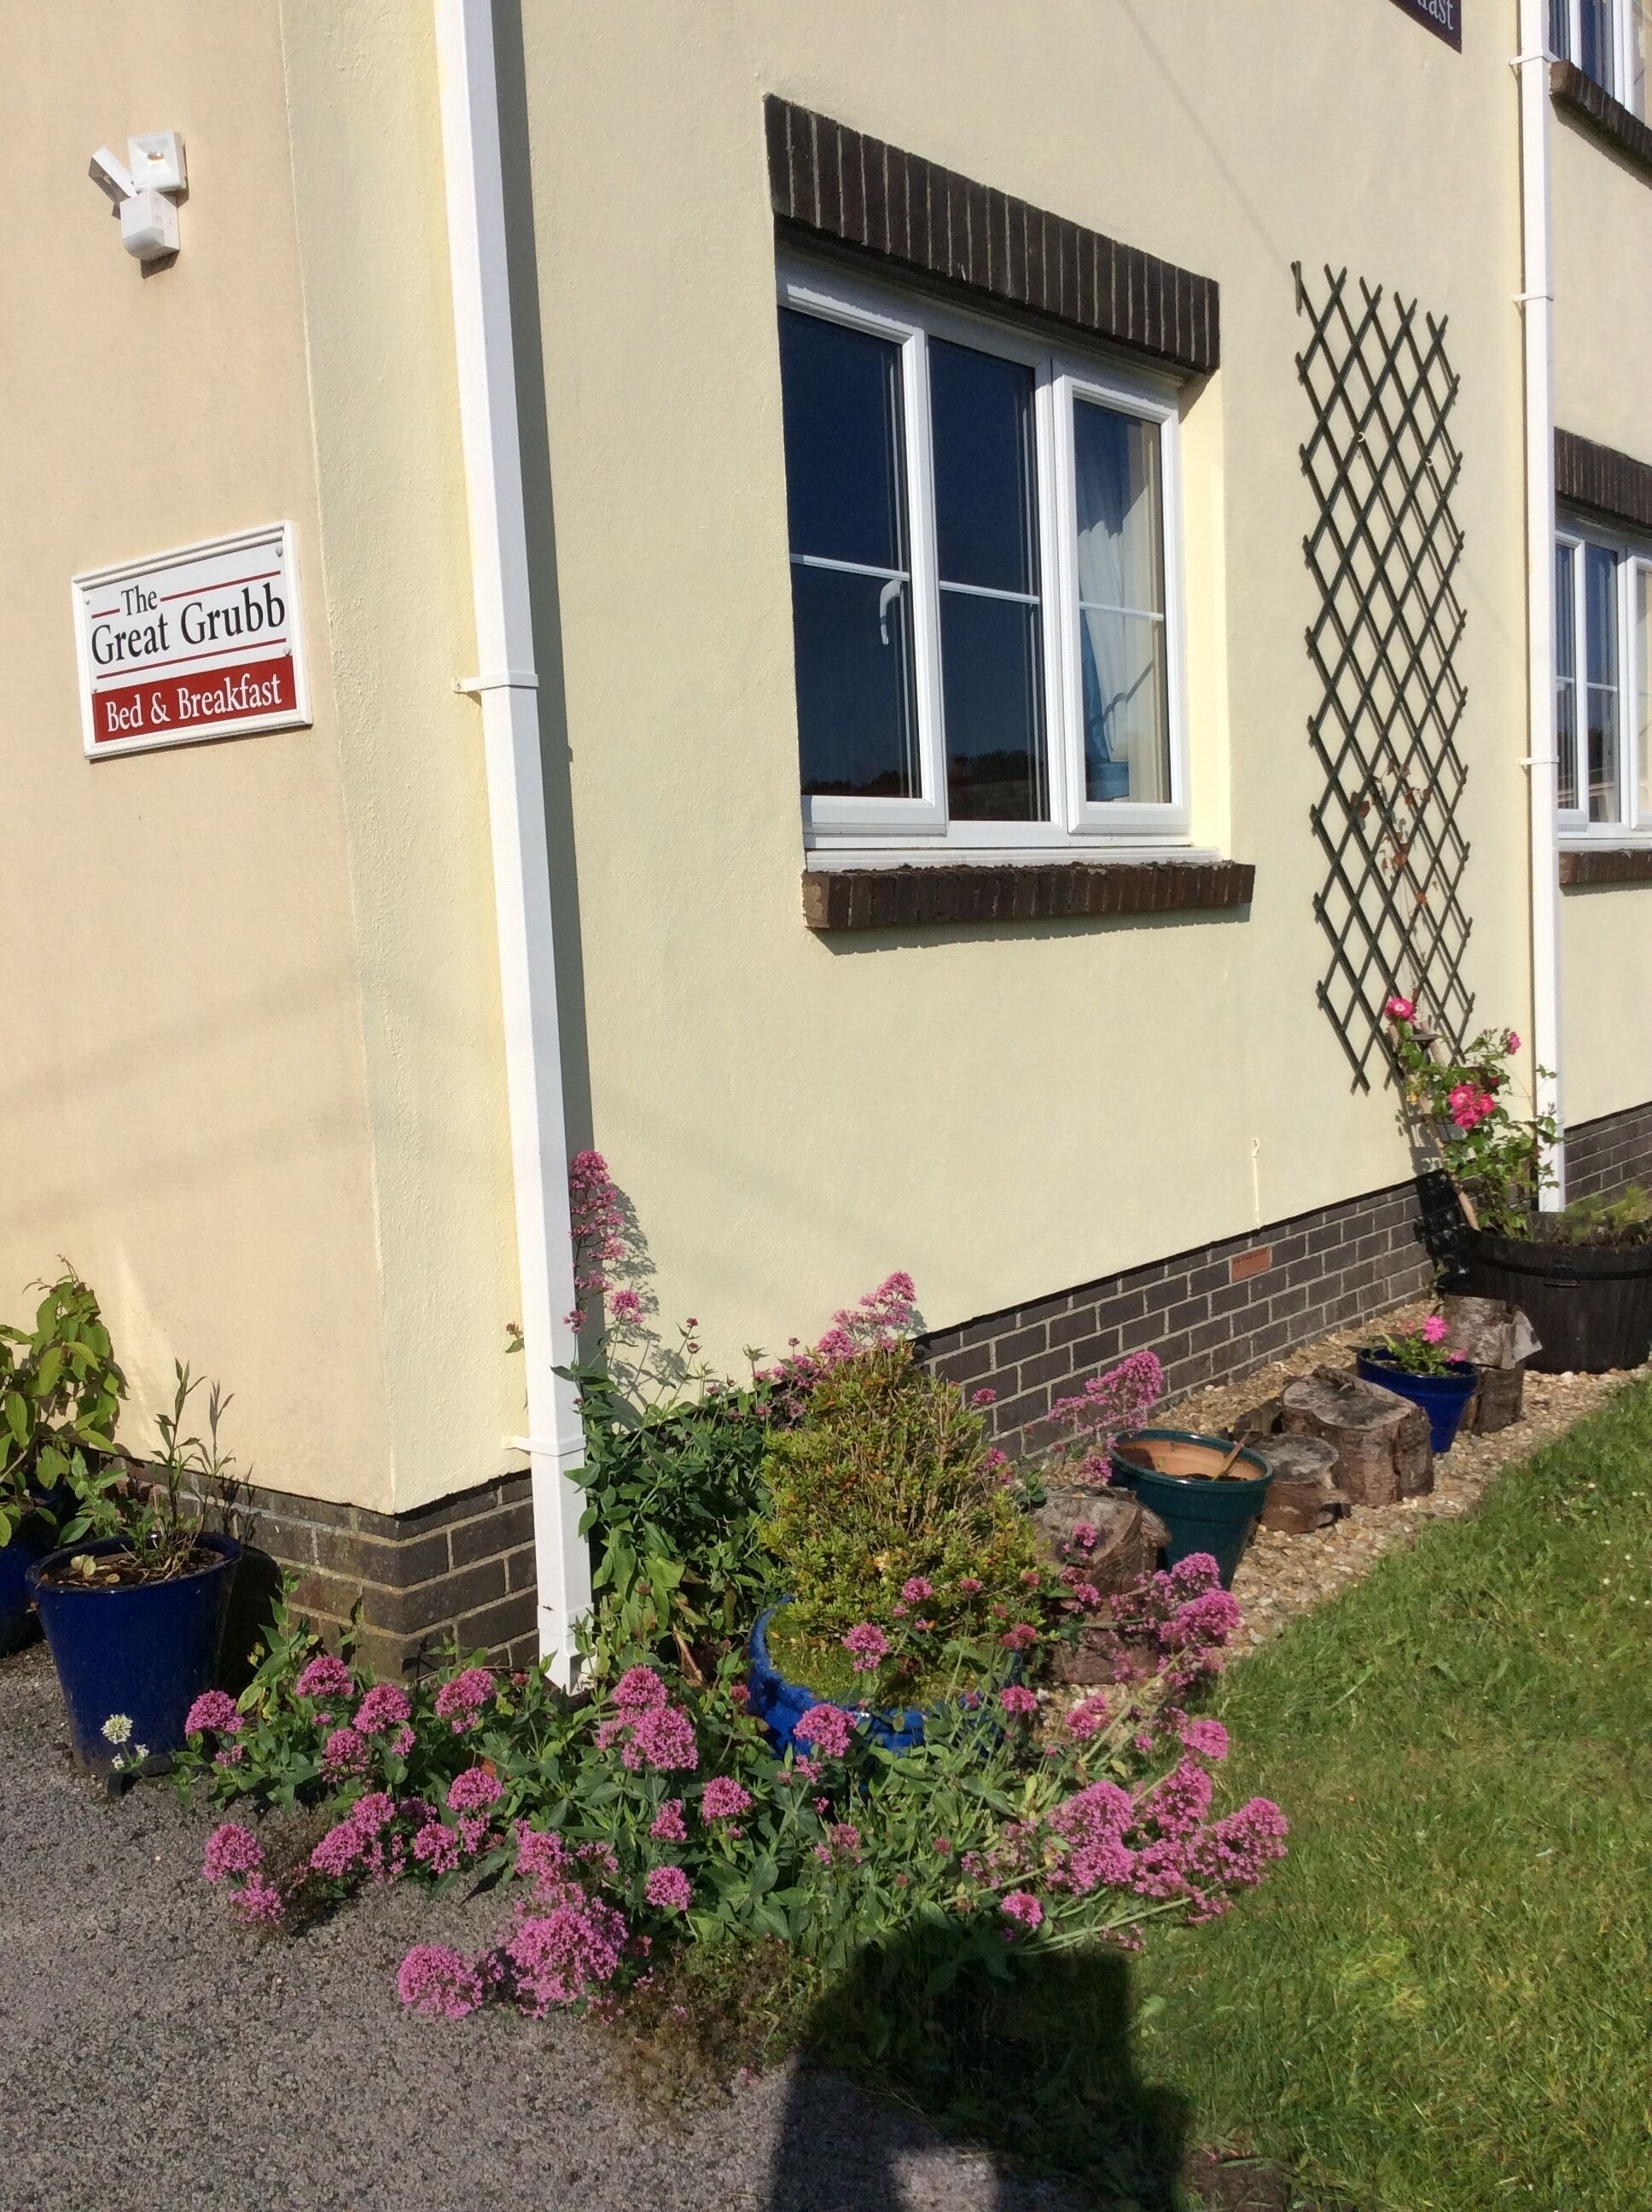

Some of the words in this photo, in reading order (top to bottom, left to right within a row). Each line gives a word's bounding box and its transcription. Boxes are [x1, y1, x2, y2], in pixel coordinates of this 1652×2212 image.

[91, 613, 170, 665] Great
[180, 582, 286, 645] Grubb
[121, 585, 158, 616] The
[106, 694, 143, 732] Bed
[150, 692, 171, 725] &
[177, 673, 282, 719] Breakfast
